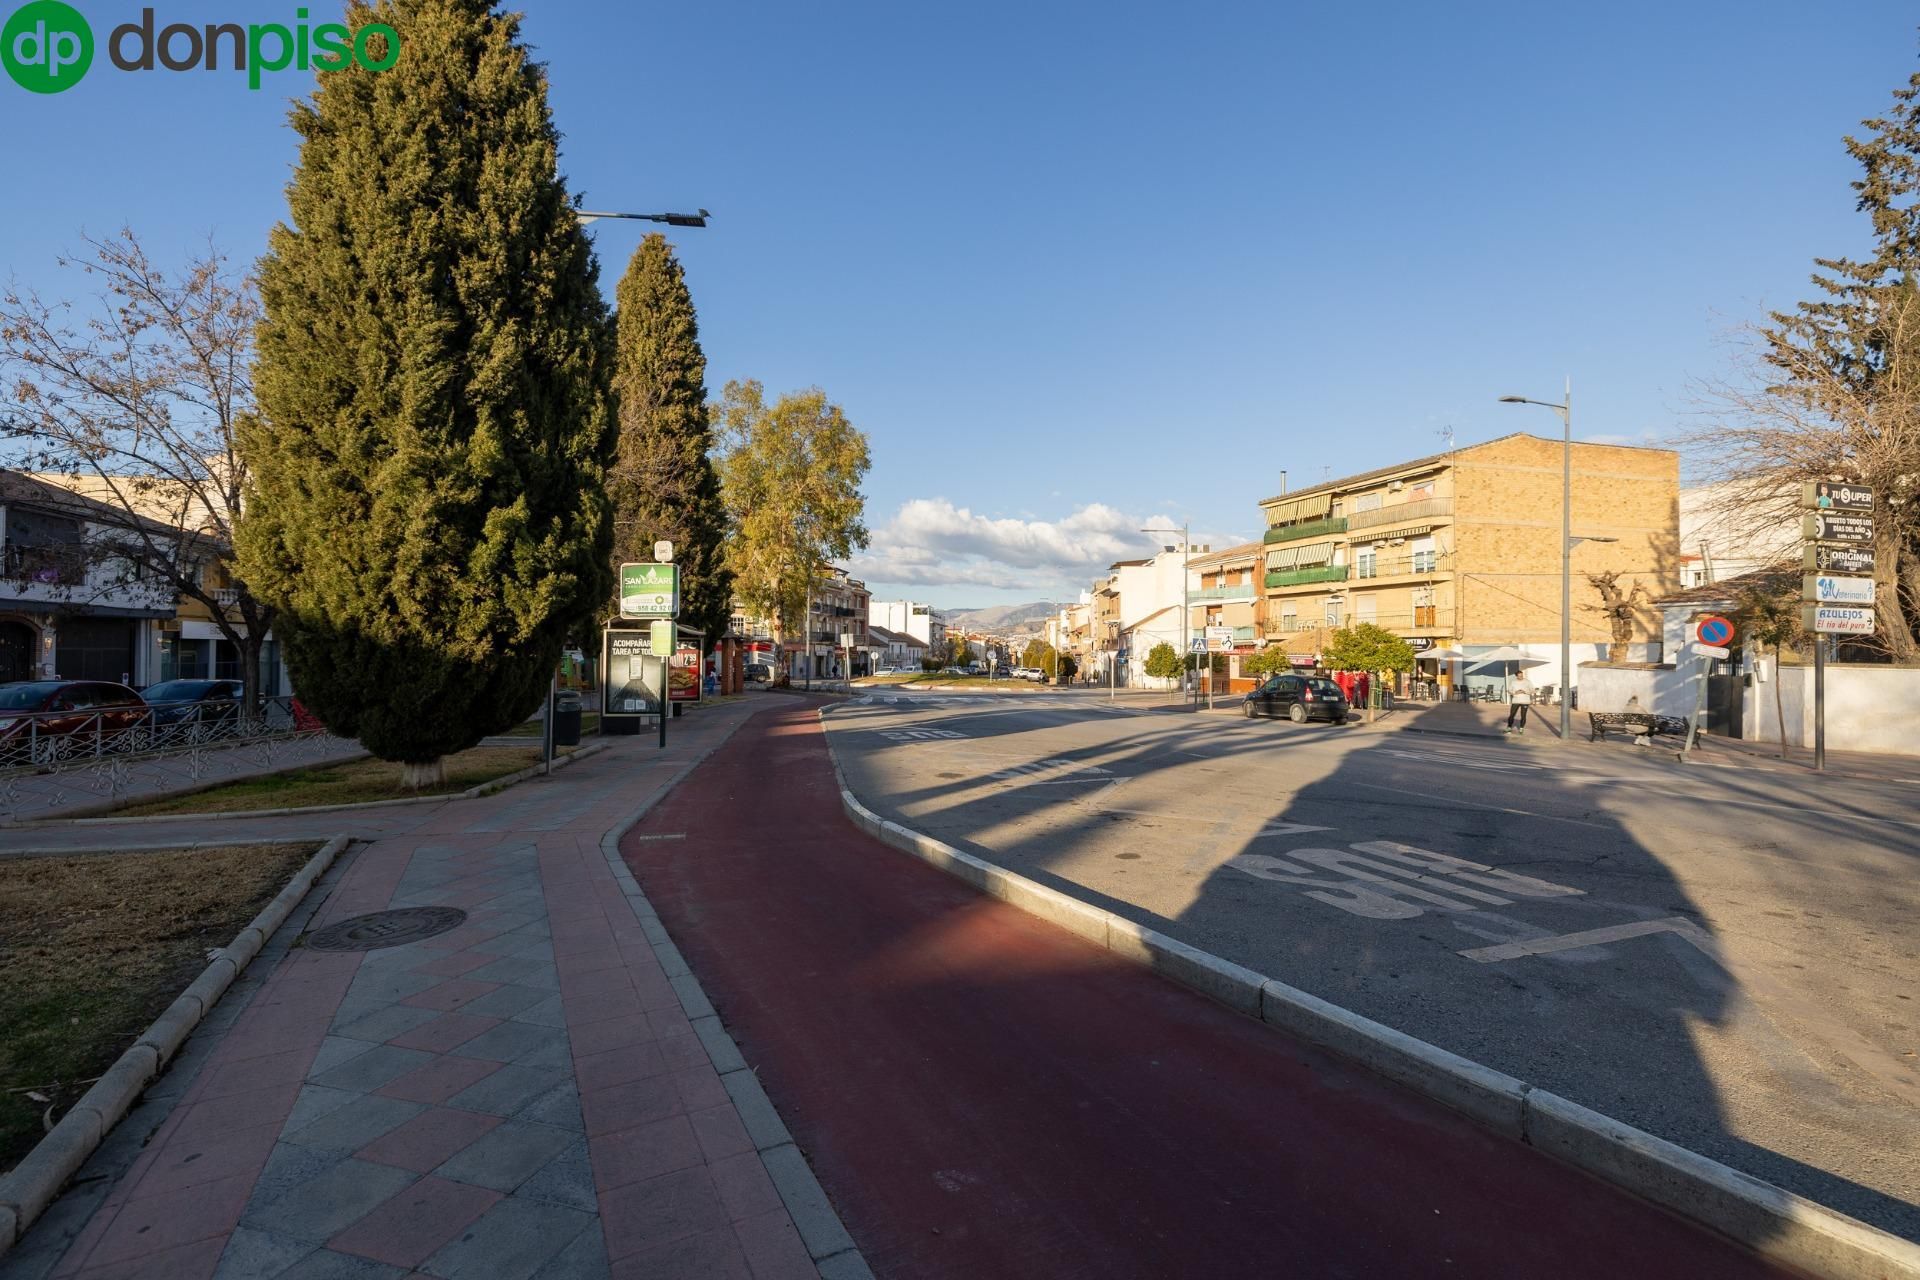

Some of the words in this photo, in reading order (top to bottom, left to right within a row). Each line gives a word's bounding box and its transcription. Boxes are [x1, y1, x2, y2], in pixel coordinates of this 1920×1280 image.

[1832, 490, 1841, 499] TU
[1832, 551, 1874, 563] ORIGINAL
[625, 577, 641, 585] SAN
[1819, 609, 1863, 620] AZULEJOS
[1816, 619, 1825, 629] El
[1838, 619, 1849, 629] del
[1849, 622, 1866, 631] puro
